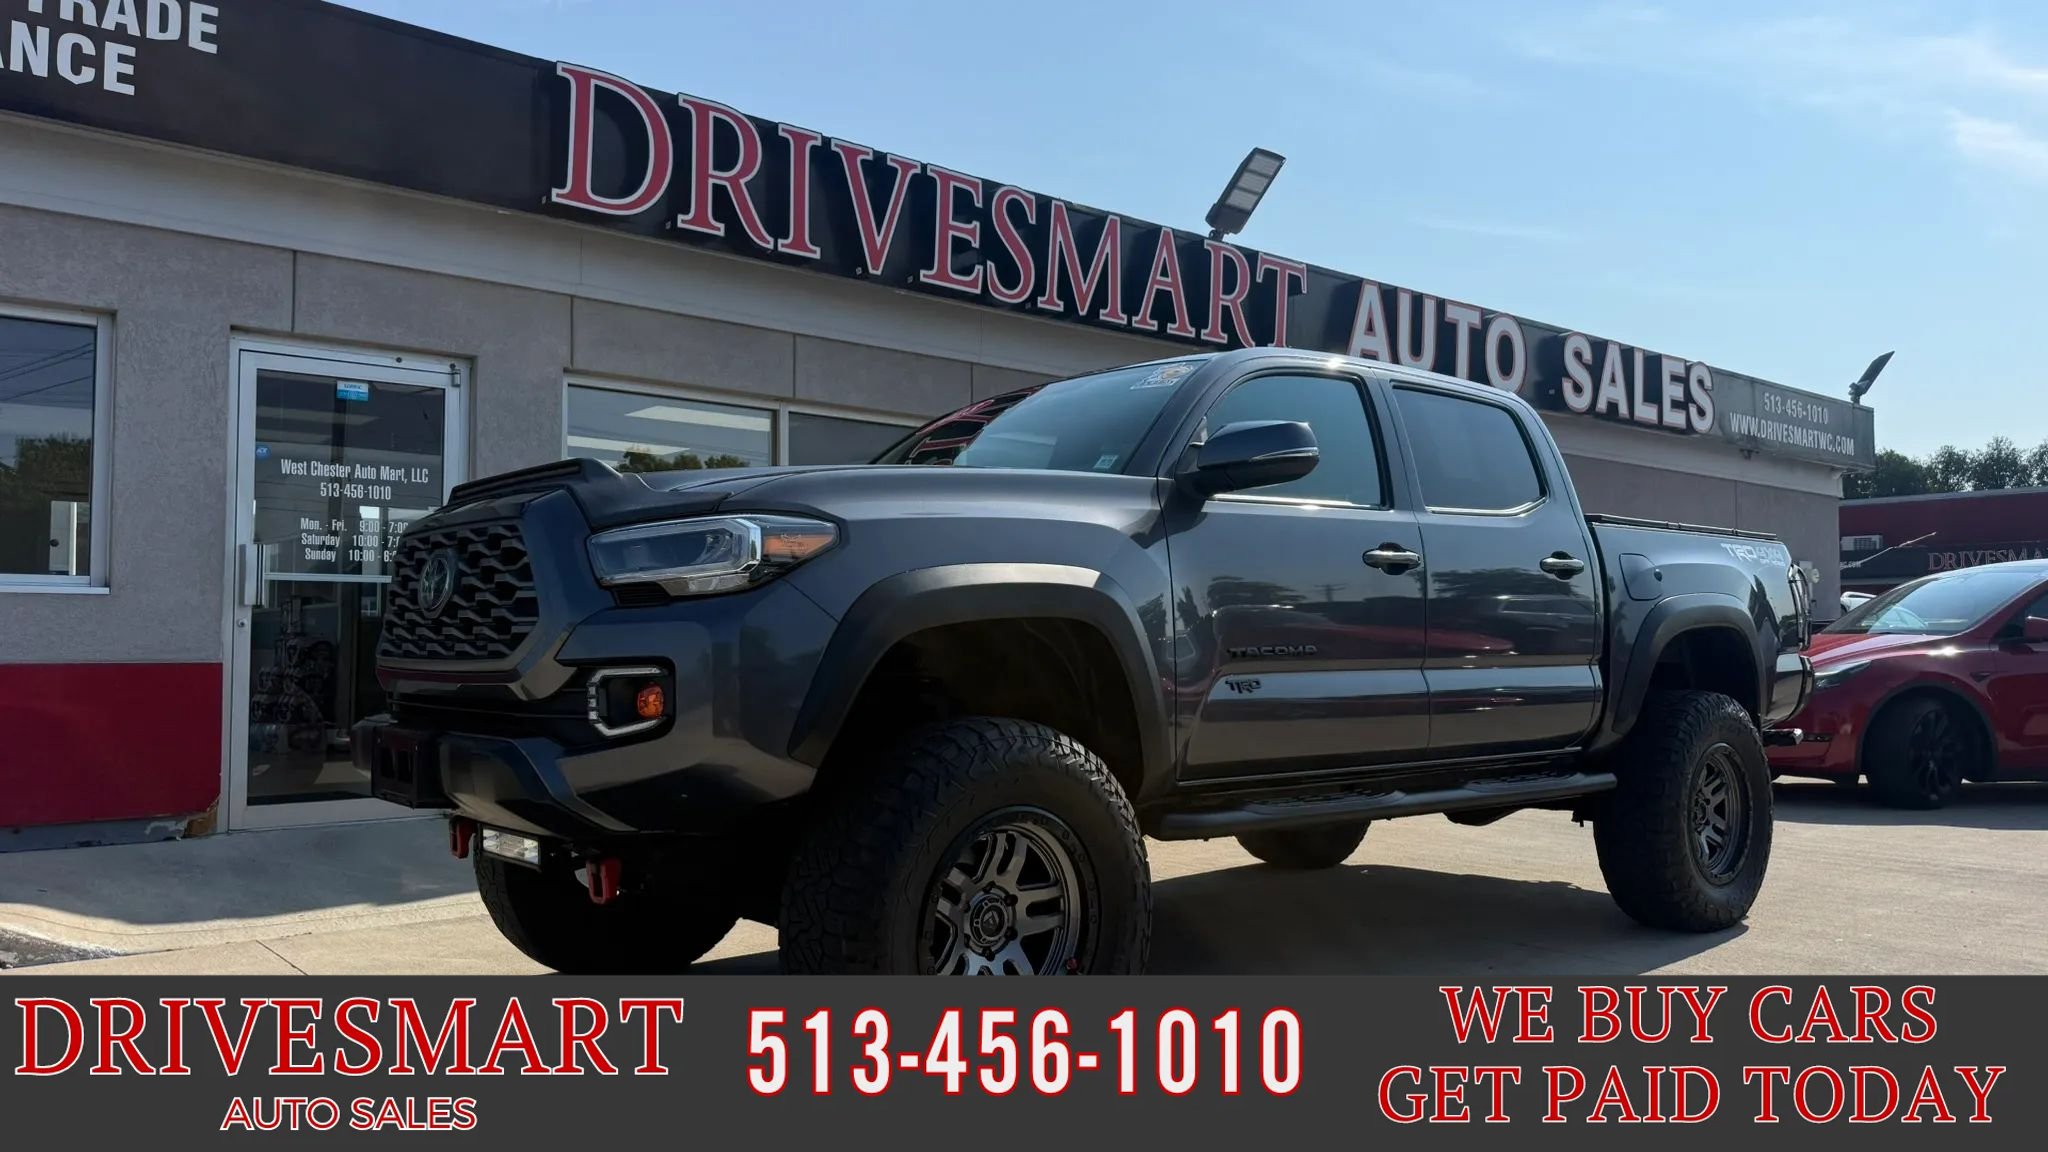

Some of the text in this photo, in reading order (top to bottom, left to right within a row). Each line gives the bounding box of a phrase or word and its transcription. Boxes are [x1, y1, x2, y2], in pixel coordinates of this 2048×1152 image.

[28, 0, 219, 54] RADE
[0, 20, 136, 96] NCE
[551, 61, 1715, 434] DRIVESMART AUTO SALES
[1764, 392, 1829, 425] 513-456-1010
[1729, 412, 1855, 456] WWW.DRIVESMARTWC.COM
[280, 459, 429, 484] West Chester Auto Mart, LLC
[320, 482, 392, 500] 513-456-1010
[300, 518, 323, 531] Mon.
[331, 519, 348, 532] Fri.
[359, 520, 380, 533] 9:00
[301, 533, 341, 547] Saturday
[352, 535, 379, 548] 10:00
[305, 548, 337, 562] Sunday
[349, 549, 375, 562] 10:00
[1720, 543, 1757, 562] TRD
[1928, 546, 2048, 572] DRIVESMA
[1227, 643, 1319, 659] TACOMA
[1225, 679, 1262, 694] TRD
